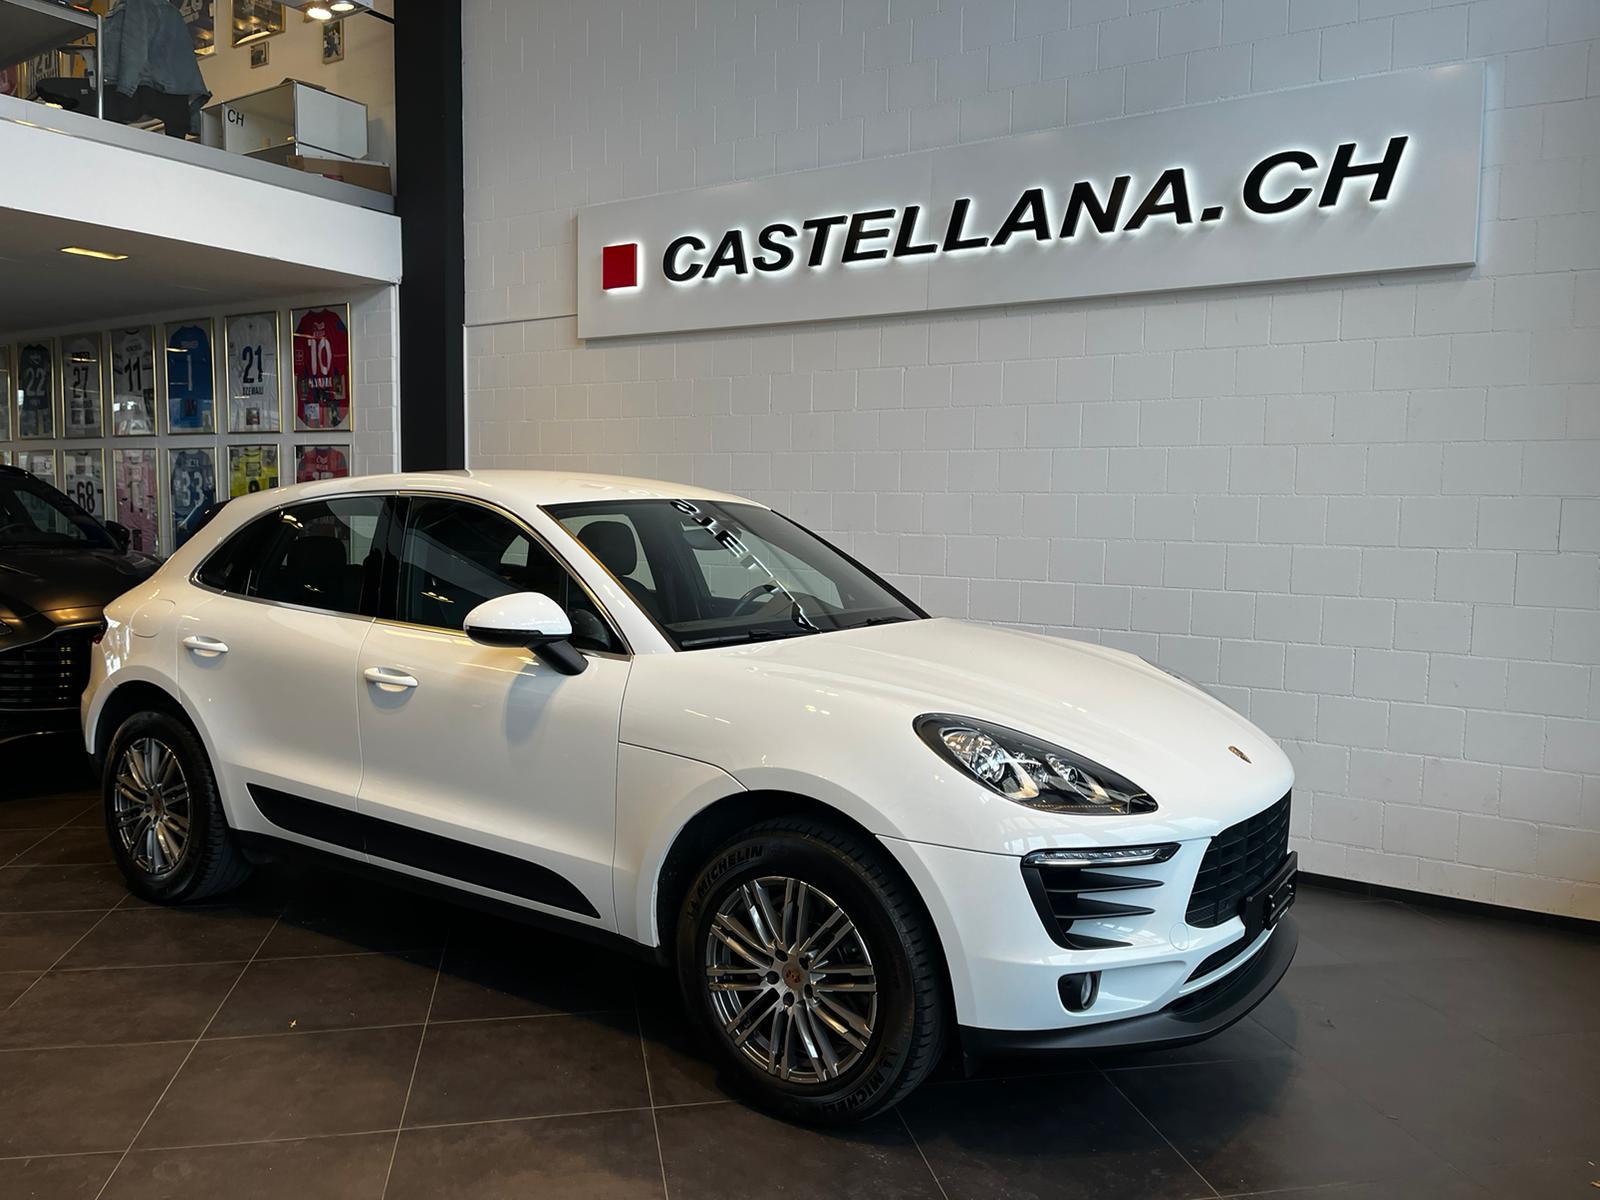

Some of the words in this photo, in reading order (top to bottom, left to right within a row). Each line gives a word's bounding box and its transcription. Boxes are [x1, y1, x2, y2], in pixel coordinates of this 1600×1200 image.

[227, 108, 245, 128] CH
[663, 135, 1409, 283] CASTELLANA.CH
[123, 356, 142, 392] 11
[242, 345, 263, 384] 21
[307, 337, 333, 376] 10
[26, 367, 46, 397] 22
[72, 366, 89, 399] 27
[77, 480, 95, 514] 68
